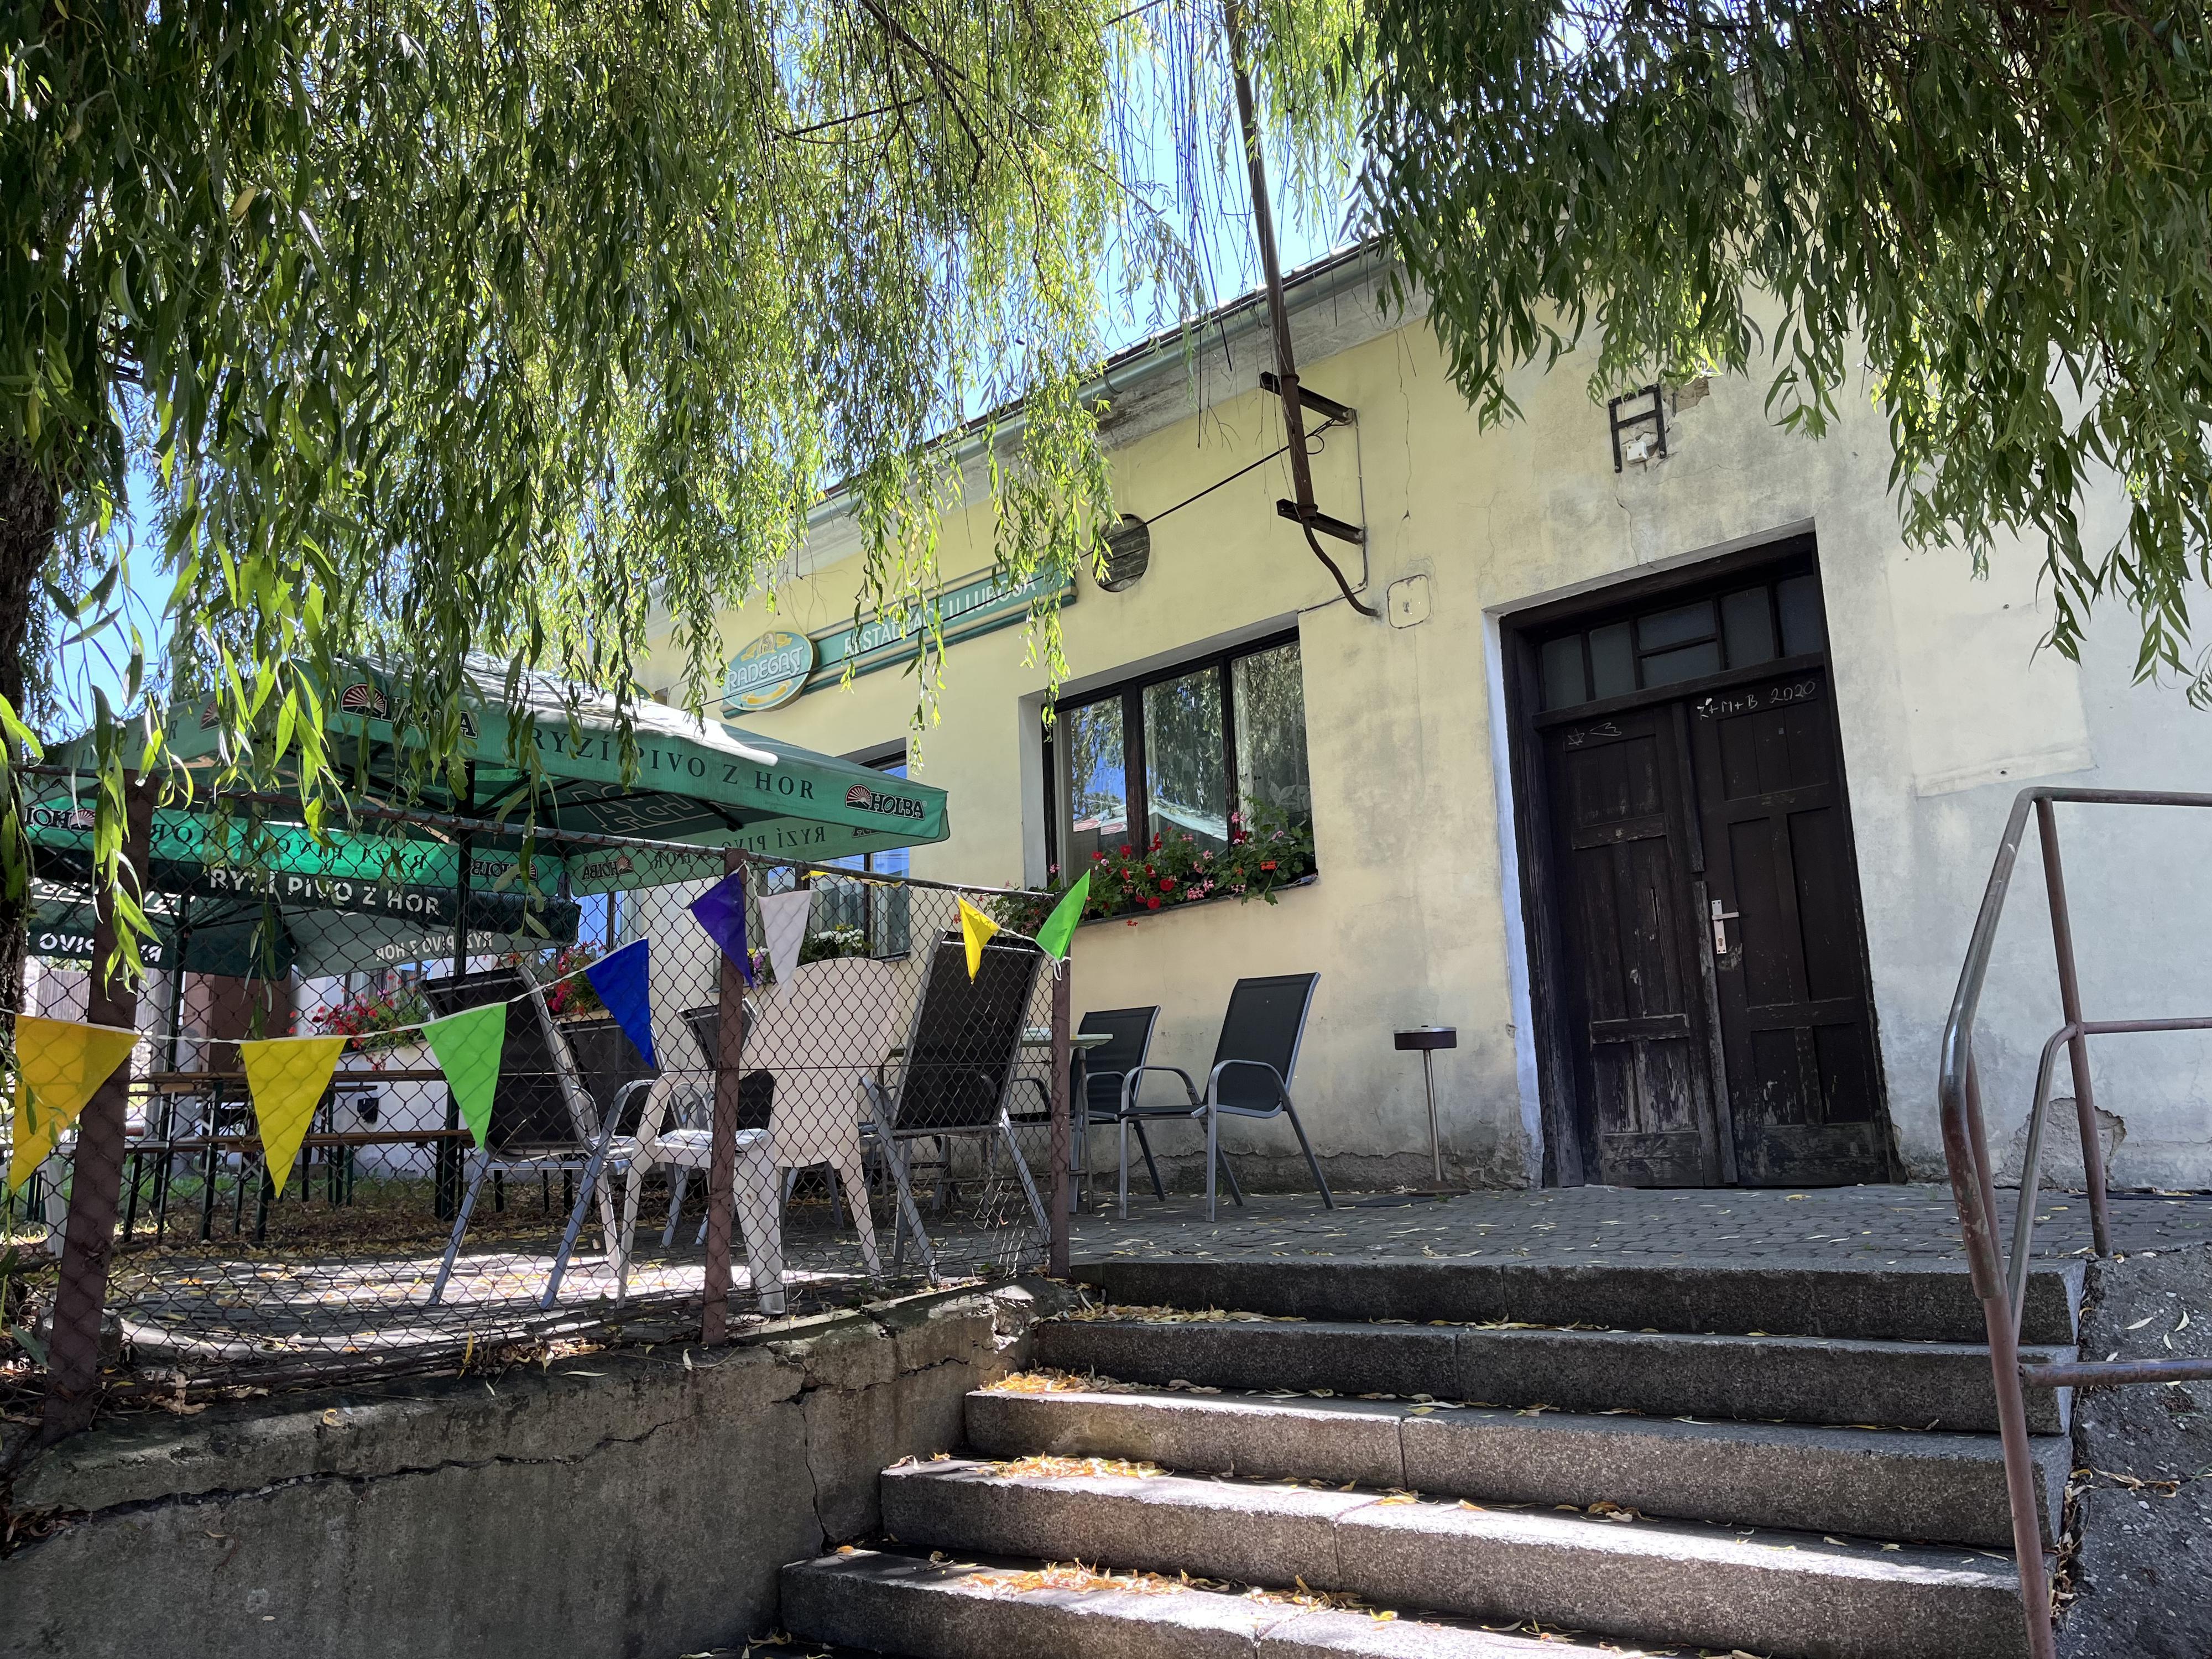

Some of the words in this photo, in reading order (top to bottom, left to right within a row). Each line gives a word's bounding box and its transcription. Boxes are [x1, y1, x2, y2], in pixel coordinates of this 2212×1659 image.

[844, 603, 944, 656] RESTAUAC
[949, 597, 960, 620] U
[727, 645, 804, 691] RADEGAST
[1770, 681, 1816, 704] 2020
[531, 727, 609, 761] RYZÍ
[722, 764, 738, 785] Z
[754, 770, 815, 800] HOR
[869, 792, 925, 820] HOLBA
[210, 869, 278, 894] RYÍ
[363, 886, 376, 905] Z
[388, 890, 441, 916] HOR
